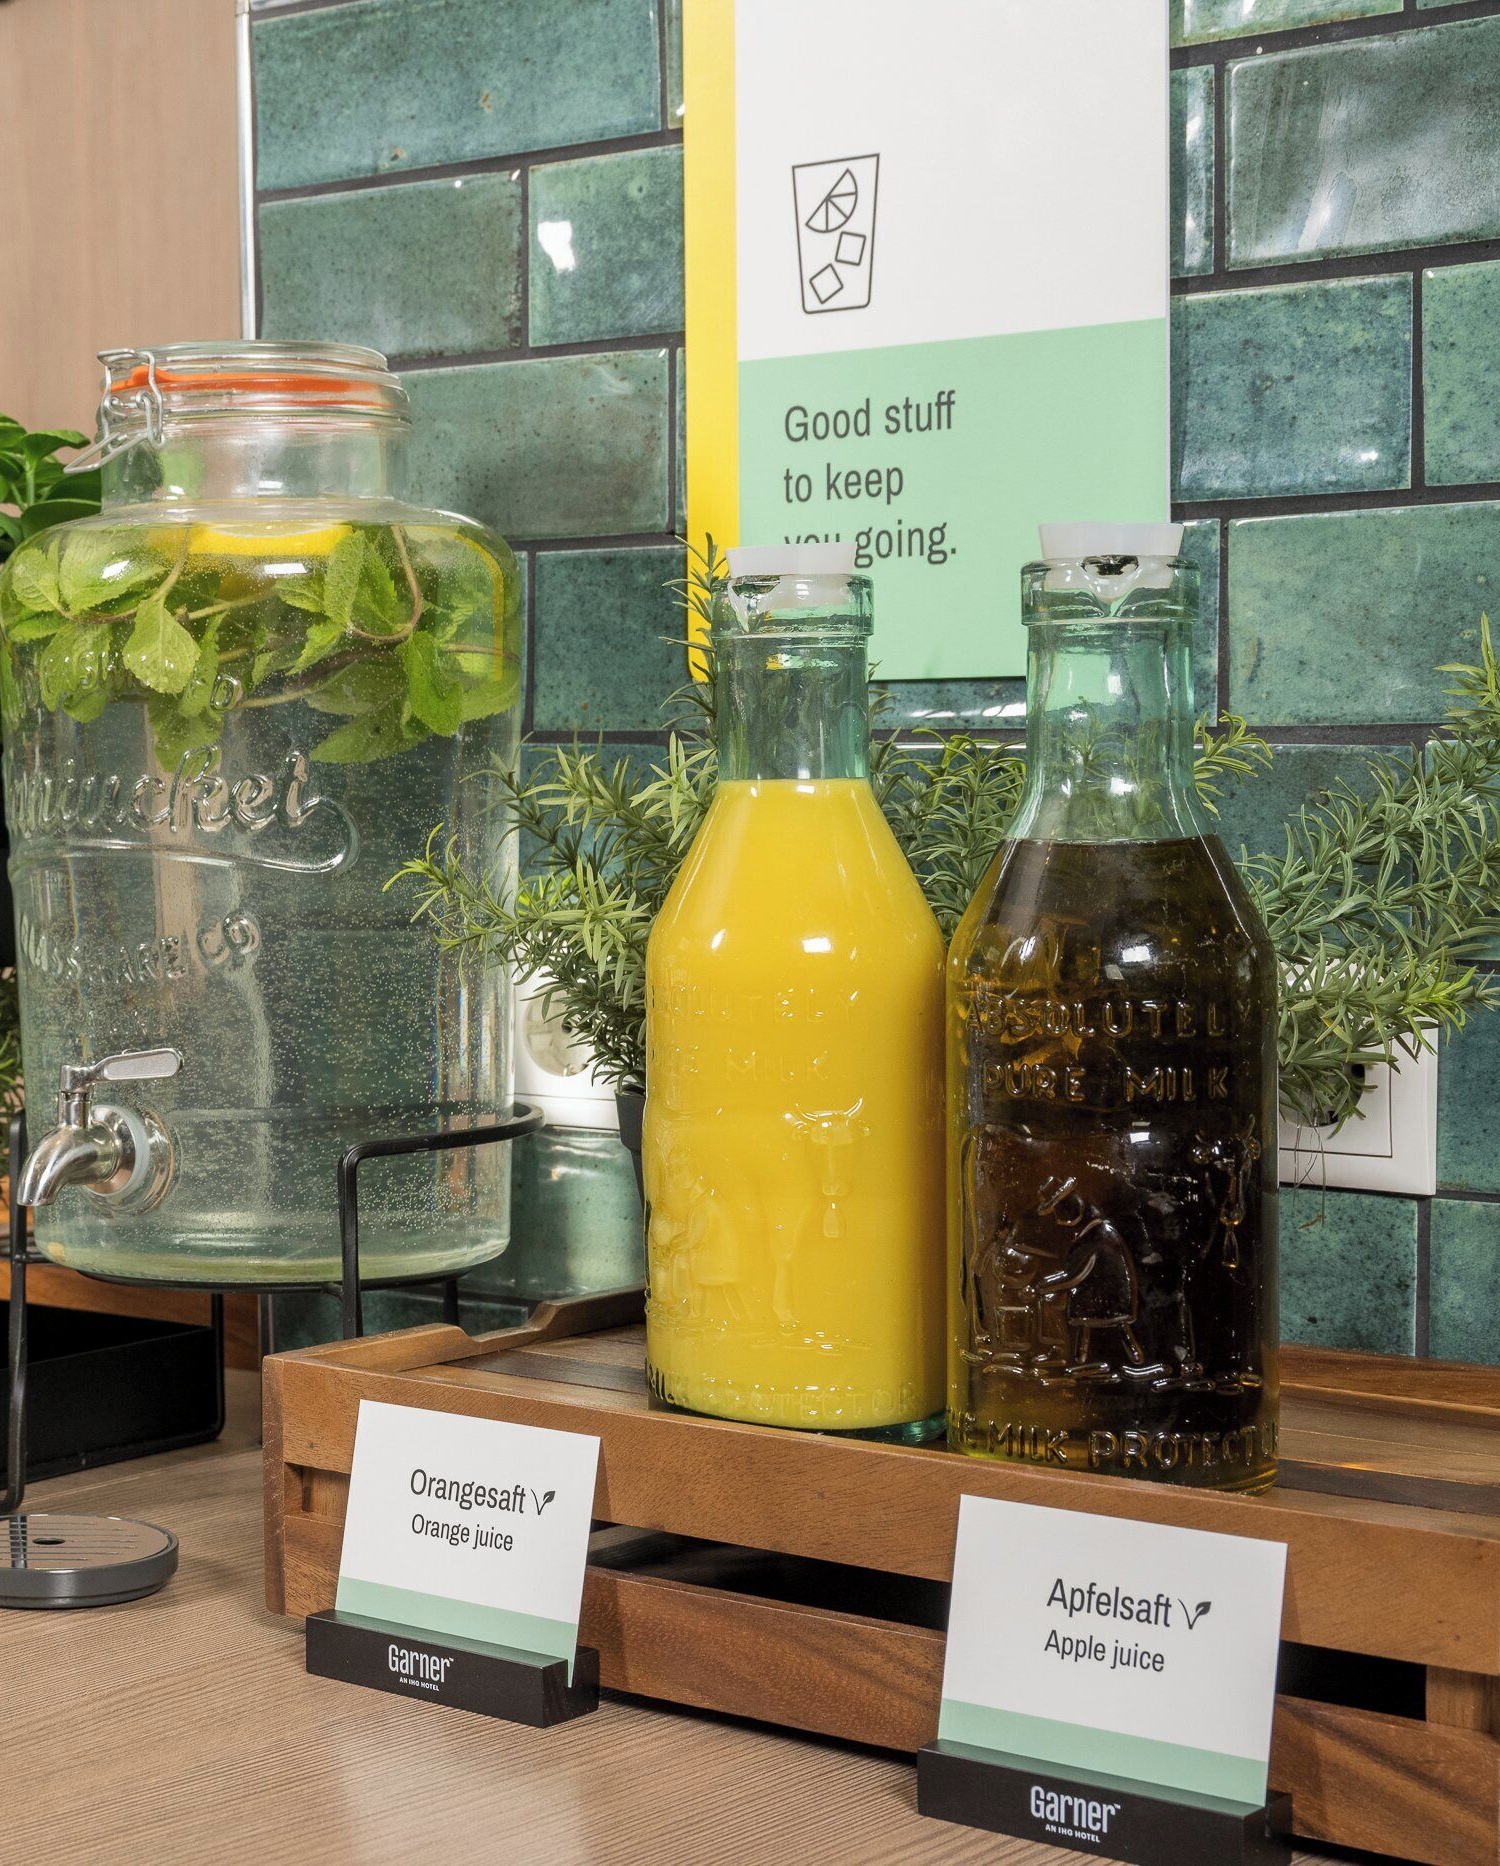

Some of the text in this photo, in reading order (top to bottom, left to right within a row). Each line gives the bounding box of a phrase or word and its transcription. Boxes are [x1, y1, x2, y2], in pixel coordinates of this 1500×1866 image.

[784, 389, 956, 443] Good stuff
[783, 462, 904, 506] to keep
[854, 518, 957, 569] going.
[982, 1062, 1229, 1103] PURE MILK
[988, 1418, 1070, 1466] MILK
[410, 1468, 526, 1514] Orangesaft
[411, 1513, 514, 1552] Orange juice
[1046, 1577, 1173, 1628] Apfelsaft
[1043, 1629, 1166, 1673] Apple juice
[399, 1676, 408, 1685] AN
[420, 1681, 440, 1692] HOTEL
[1045, 1823, 1101, 1843] AN IHG HOTEL
